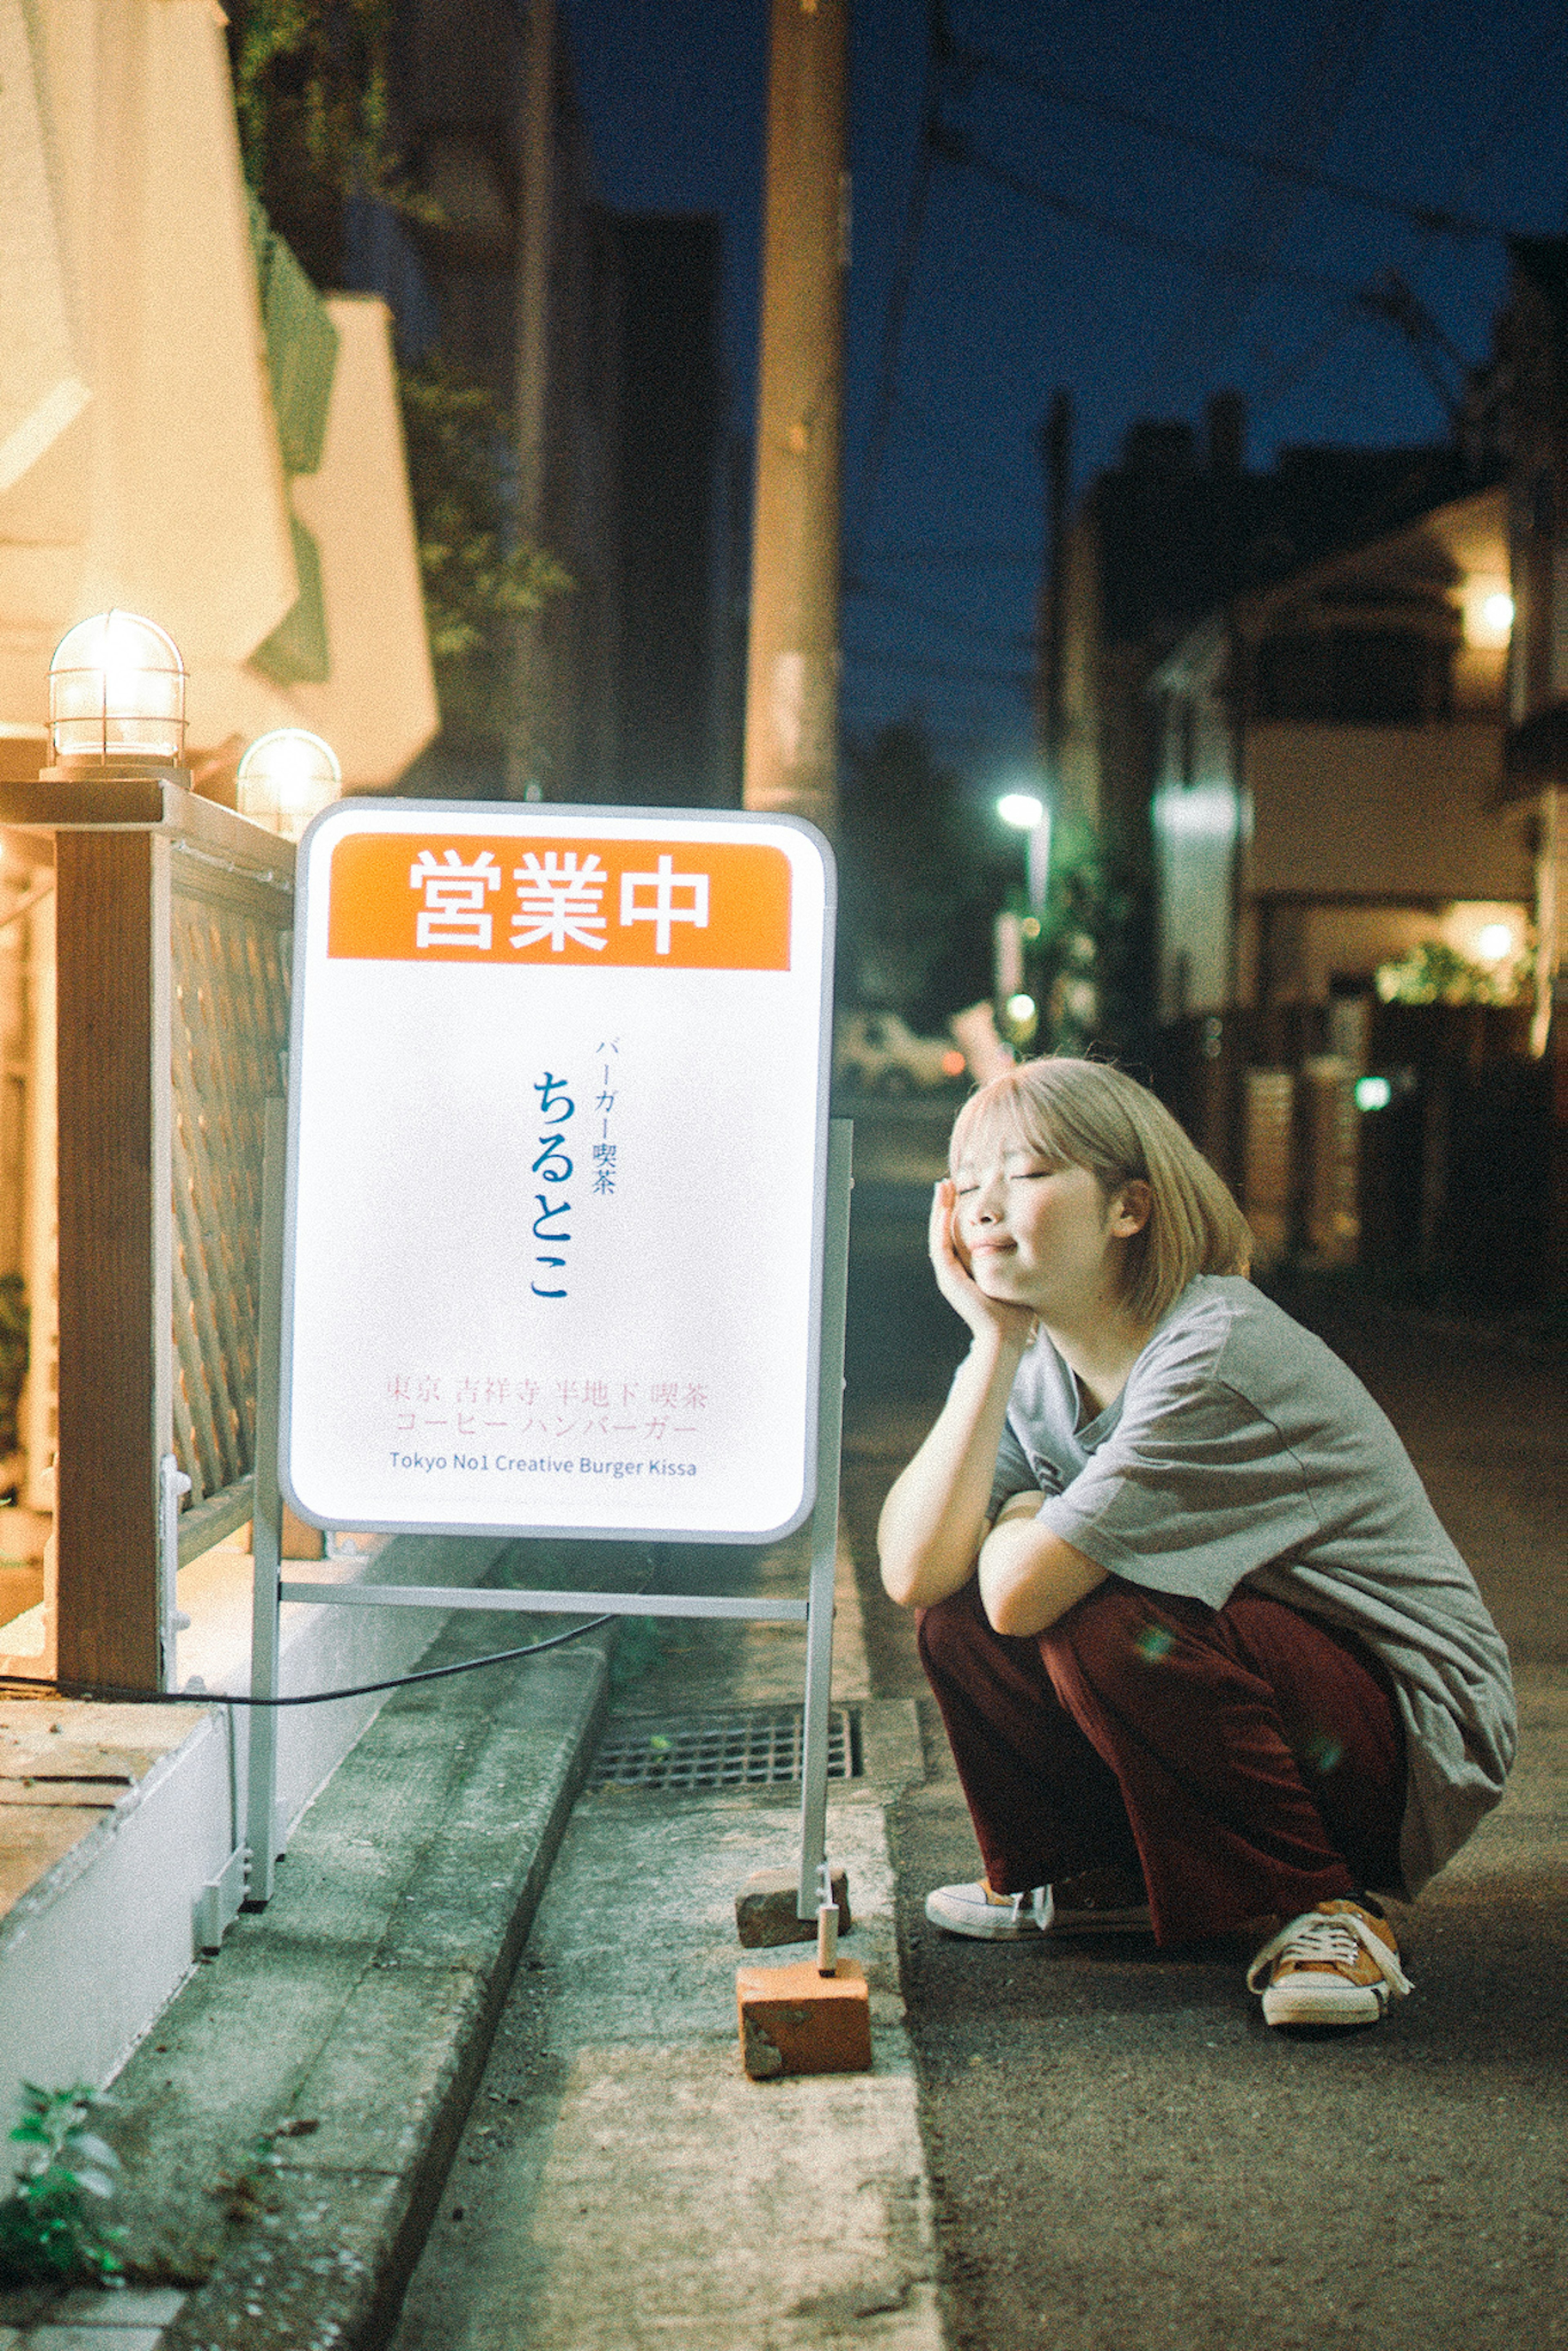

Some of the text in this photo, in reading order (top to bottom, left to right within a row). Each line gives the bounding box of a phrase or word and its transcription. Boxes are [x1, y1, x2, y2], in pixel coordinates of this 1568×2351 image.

[410, 849, 710, 955] 営業中
[592, 1037, 620, 1195] バーガー喫茶
[531, 1071, 575, 1299] ちるとこ
[387, 1374, 708, 1409] 東京 吉祥寺 半地下 喫茶
[397, 1412, 697, 1440] コーヒー ハンバーガー
[390, 1451, 697, 1479] Tokyo No1 Creative Burger Kissa
